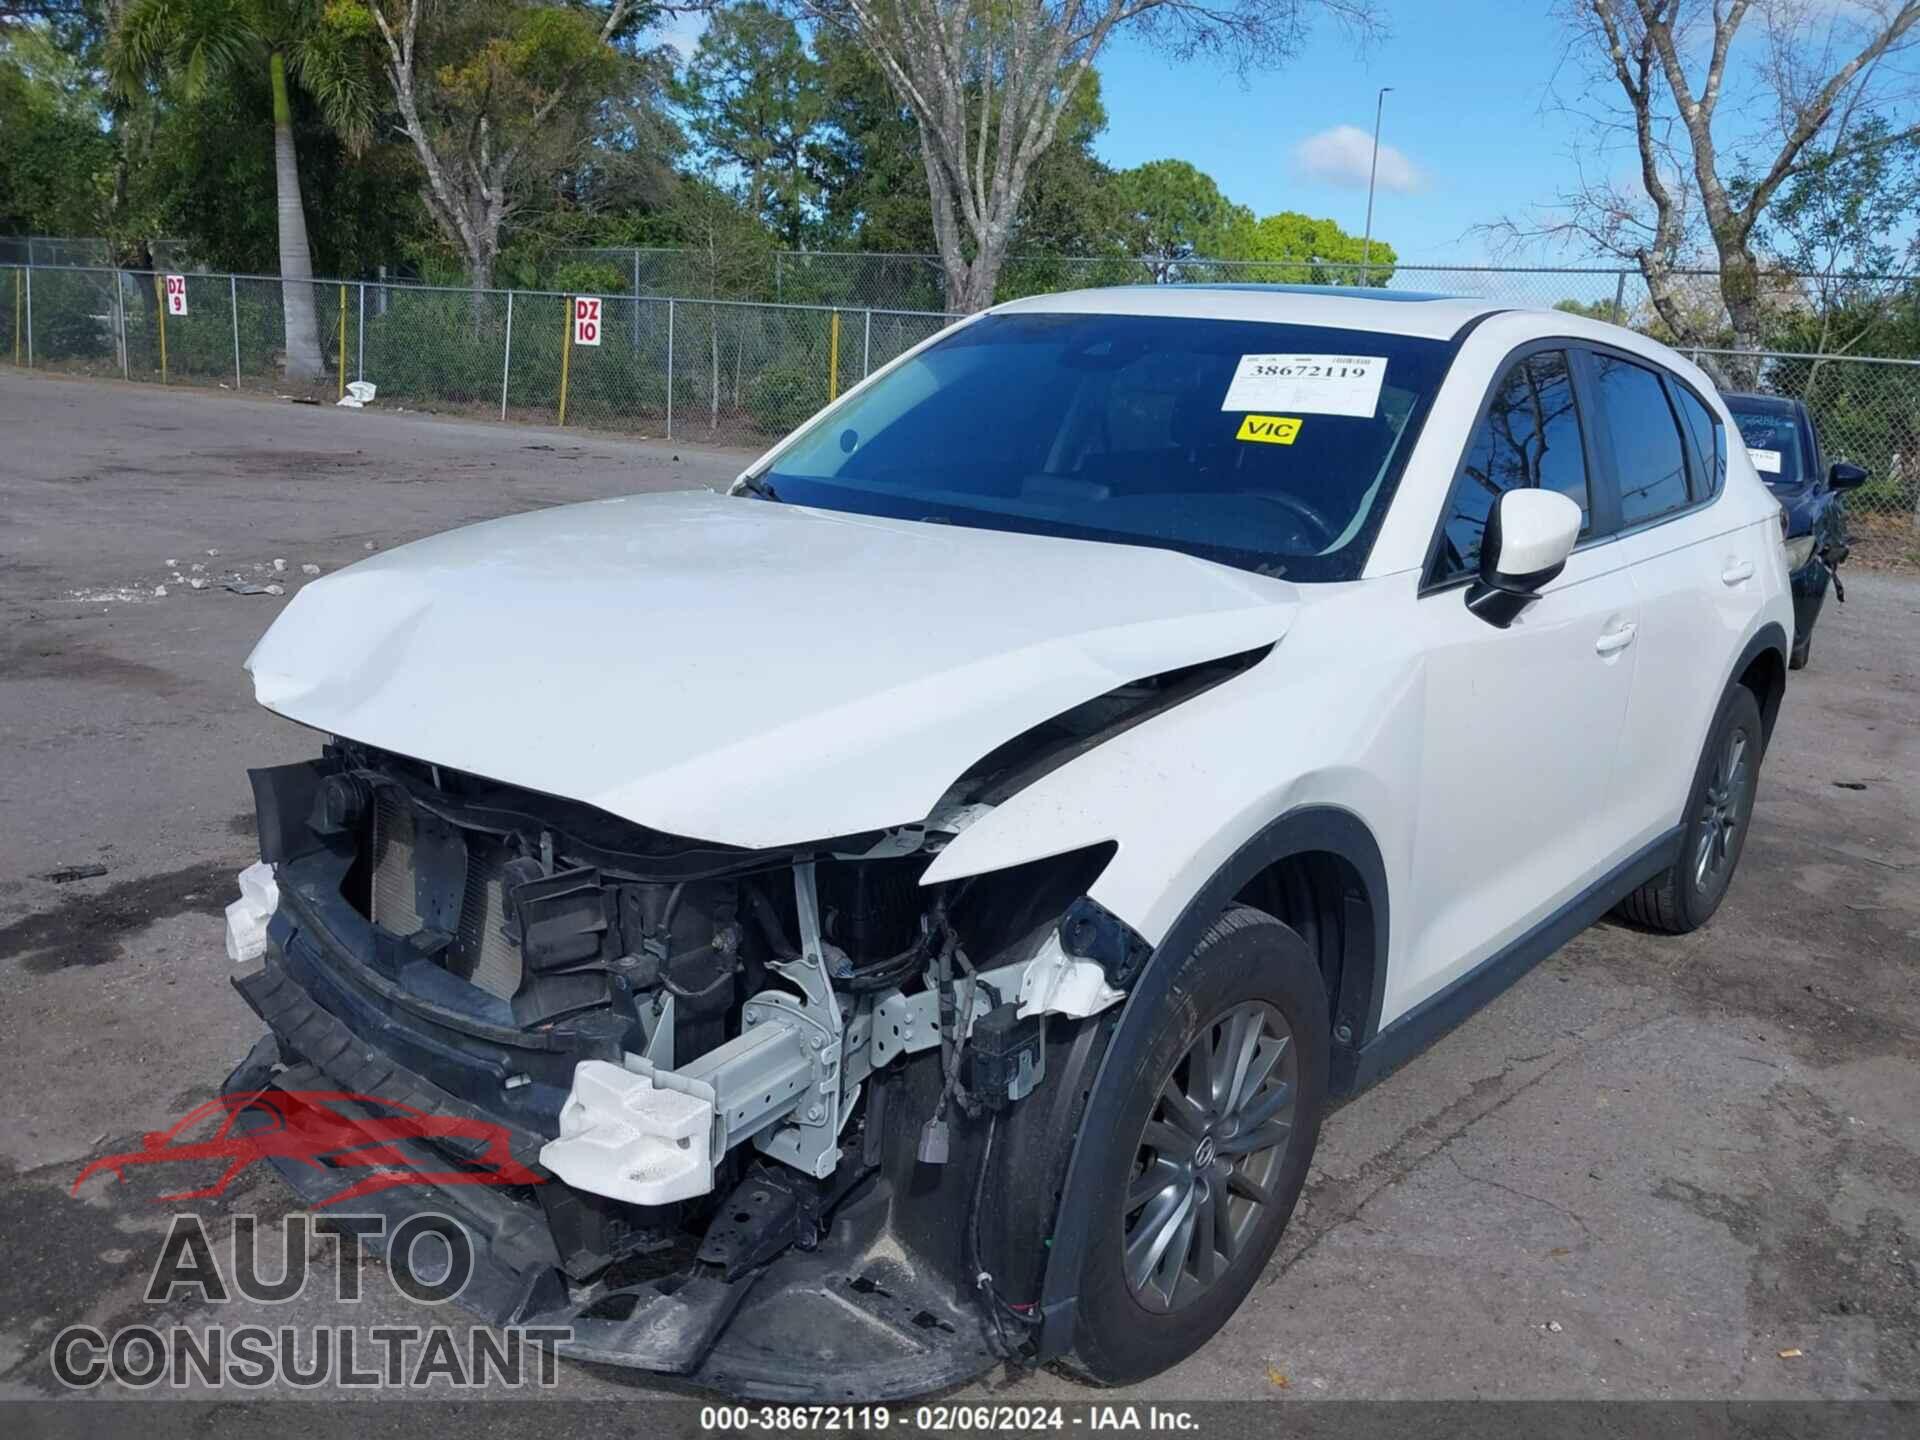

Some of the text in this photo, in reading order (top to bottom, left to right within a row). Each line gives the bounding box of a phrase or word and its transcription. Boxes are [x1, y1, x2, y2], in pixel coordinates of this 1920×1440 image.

[168, 278, 184, 294] DZ
[174, 296, 182, 311] 9
[577, 300, 599, 320] DZ
[579, 322, 596, 341] 10
[1251, 365, 1366, 378] 38672119
[1248, 421, 1293, 438] VIC
